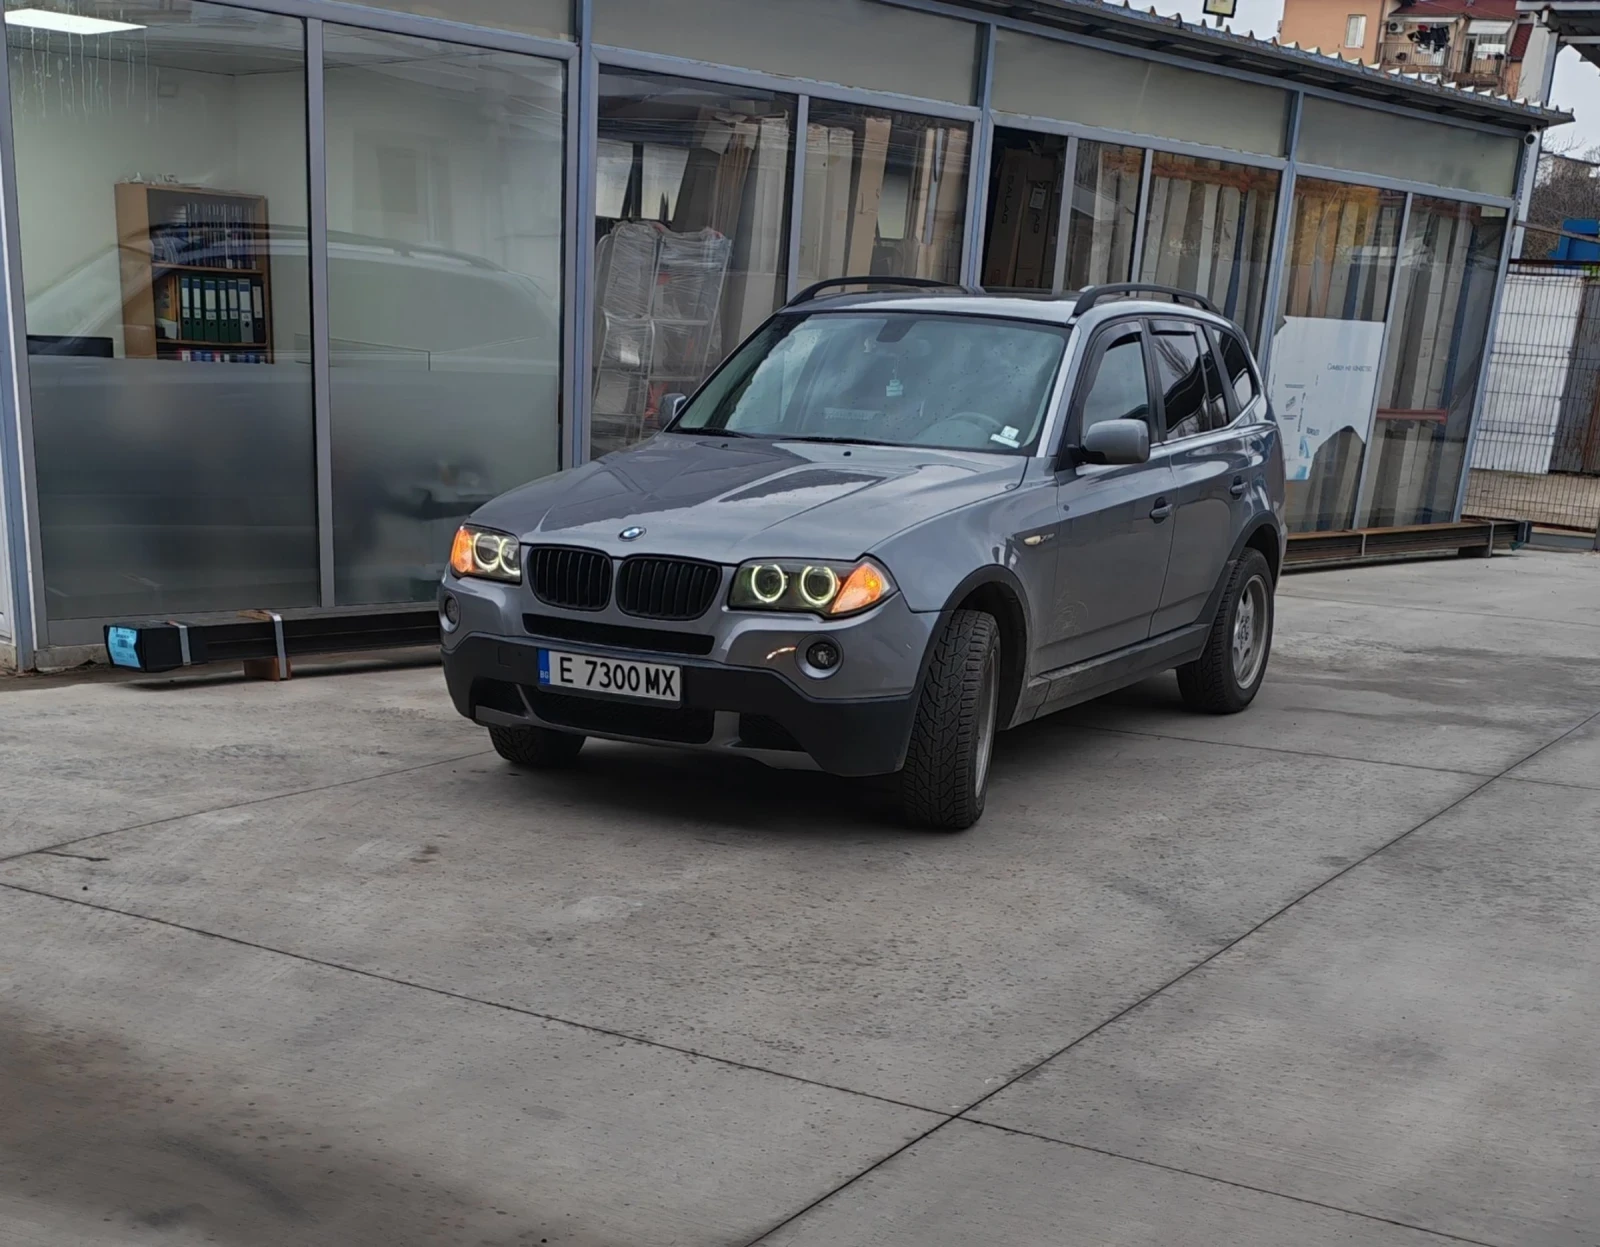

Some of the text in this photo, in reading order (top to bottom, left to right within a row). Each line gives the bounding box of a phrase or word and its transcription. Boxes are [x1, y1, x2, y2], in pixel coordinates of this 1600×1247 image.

[539, 669, 549, 680] BG
[560, 656, 676, 697] E 7300 MX
